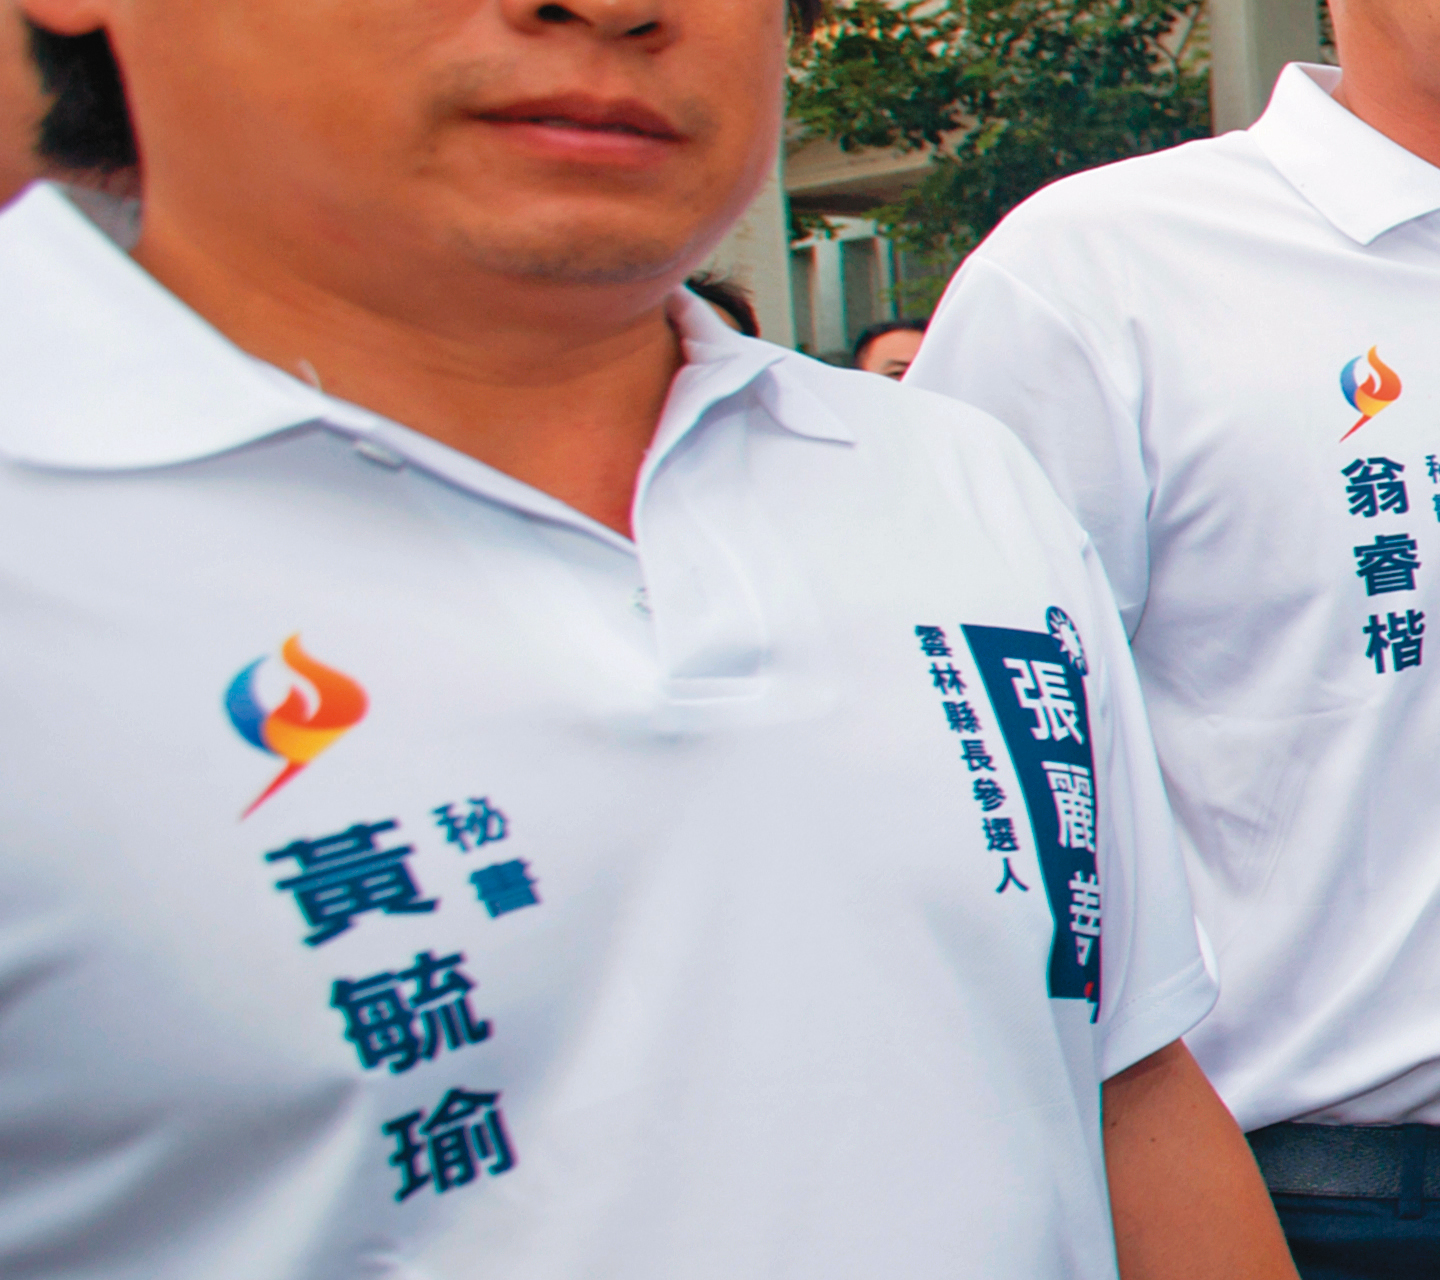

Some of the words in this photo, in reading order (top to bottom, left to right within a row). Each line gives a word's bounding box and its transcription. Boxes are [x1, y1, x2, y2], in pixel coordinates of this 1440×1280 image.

[1340, 456, 1426, 675] 翁睿楷
[431, 796, 542, 920] 秘書
[914, 624, 1030, 894] 雲林縣長參選人
[264, 816, 520, 1206] 黃毓瑜
